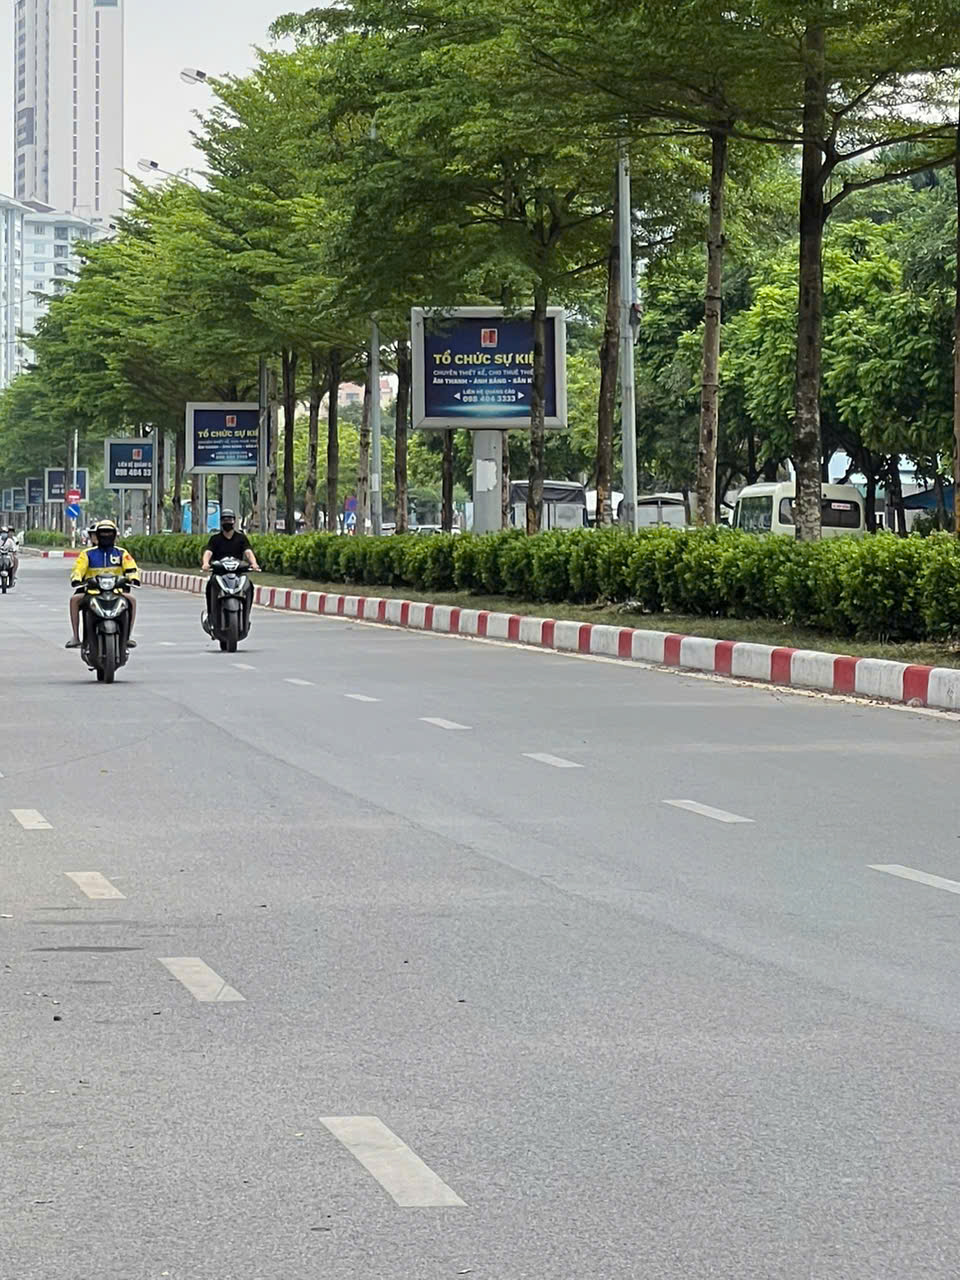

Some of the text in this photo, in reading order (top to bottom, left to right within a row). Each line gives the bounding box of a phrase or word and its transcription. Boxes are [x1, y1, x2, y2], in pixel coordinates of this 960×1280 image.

[433, 349, 534, 367] TỔ CHỨC SỰ KIỆ
